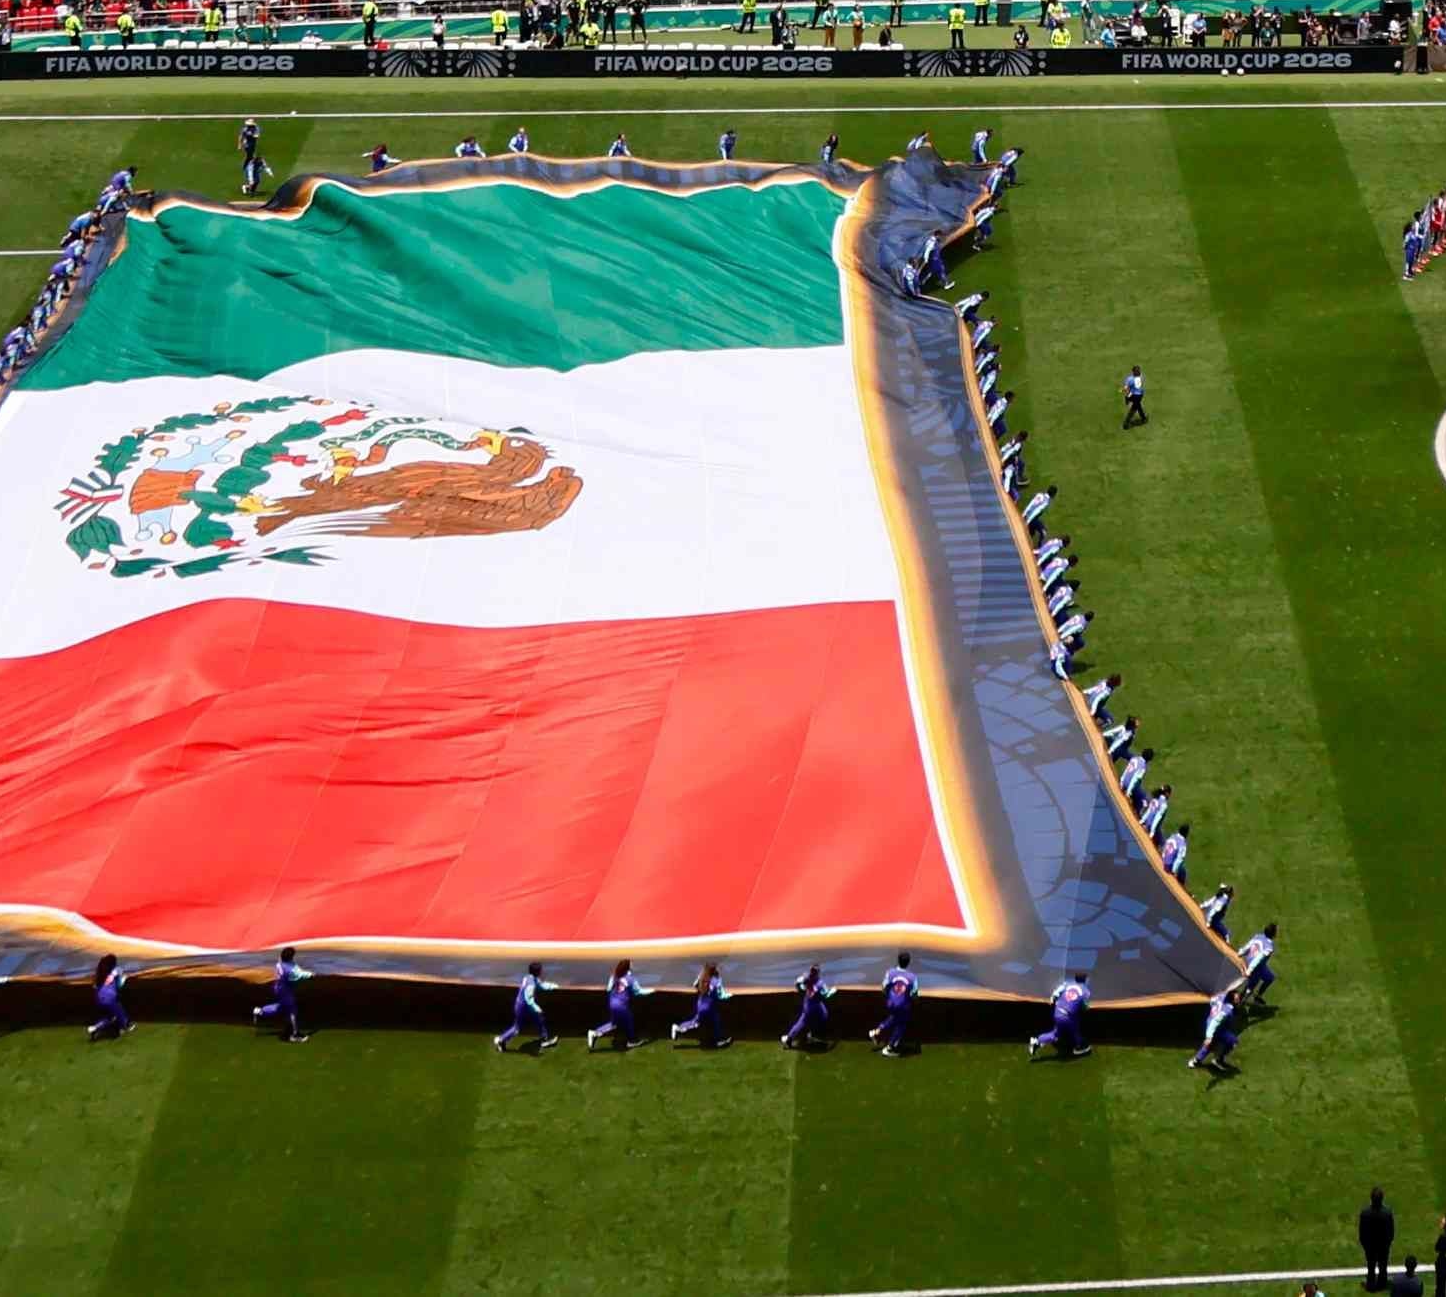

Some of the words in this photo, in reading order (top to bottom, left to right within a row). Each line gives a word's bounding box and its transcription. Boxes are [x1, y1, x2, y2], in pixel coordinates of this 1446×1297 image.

[46, 57, 91, 73] FIFA
[94, 55, 171, 72] WORLD
[175, 55, 218, 71] CUP
[221, 55, 294, 71] 2026
[594, 56, 640, 72] FIFA
[642, 56, 714, 71] WORLD
[719, 56, 759, 71] CUP
[762, 56, 833, 72] 2026
[1122, 54, 1164, 69] FIFA
[1167, 54, 1238, 69] WORLD
[1242, 53, 1281, 68] CUP
[1284, 53, 1352, 67] 2026
